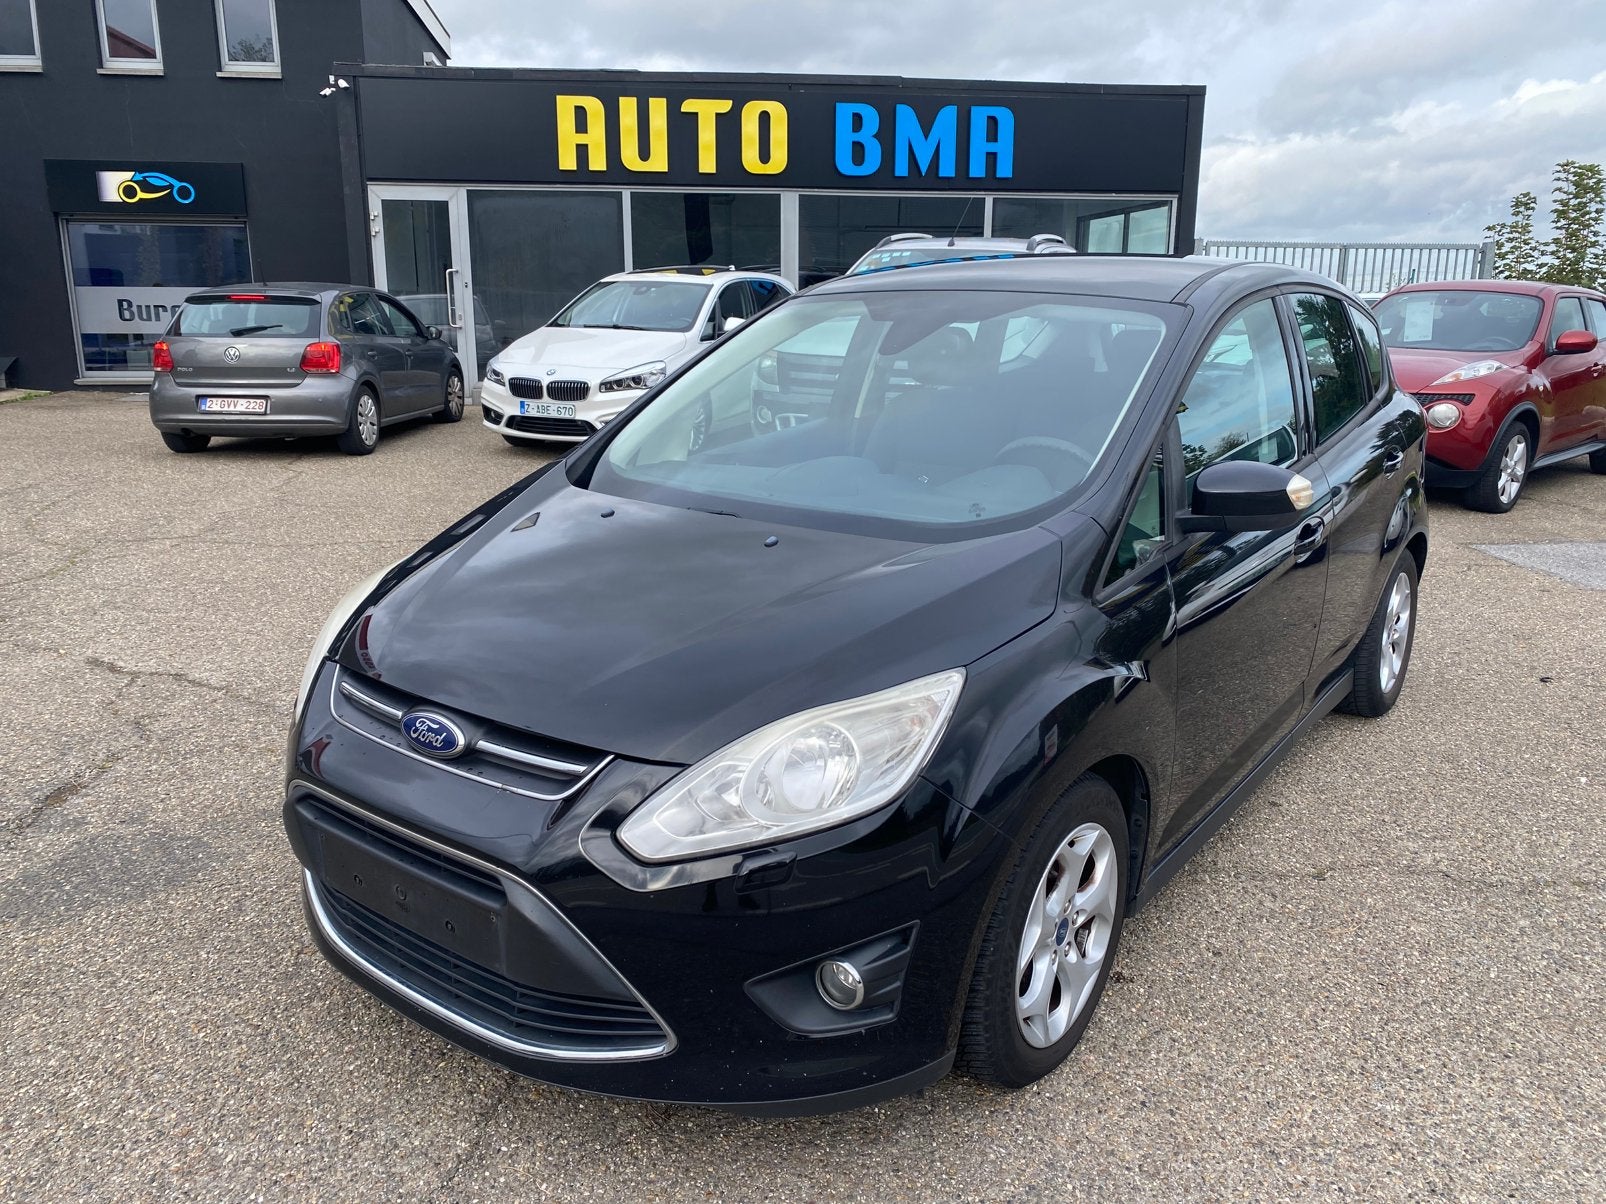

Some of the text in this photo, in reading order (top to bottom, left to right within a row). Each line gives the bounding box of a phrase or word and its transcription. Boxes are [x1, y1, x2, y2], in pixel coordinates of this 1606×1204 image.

[556, 95, 1015, 178] AUTO BMA
[525, 403, 574, 417] Z-ABE-670
[410, 718, 447, 747] Ford
